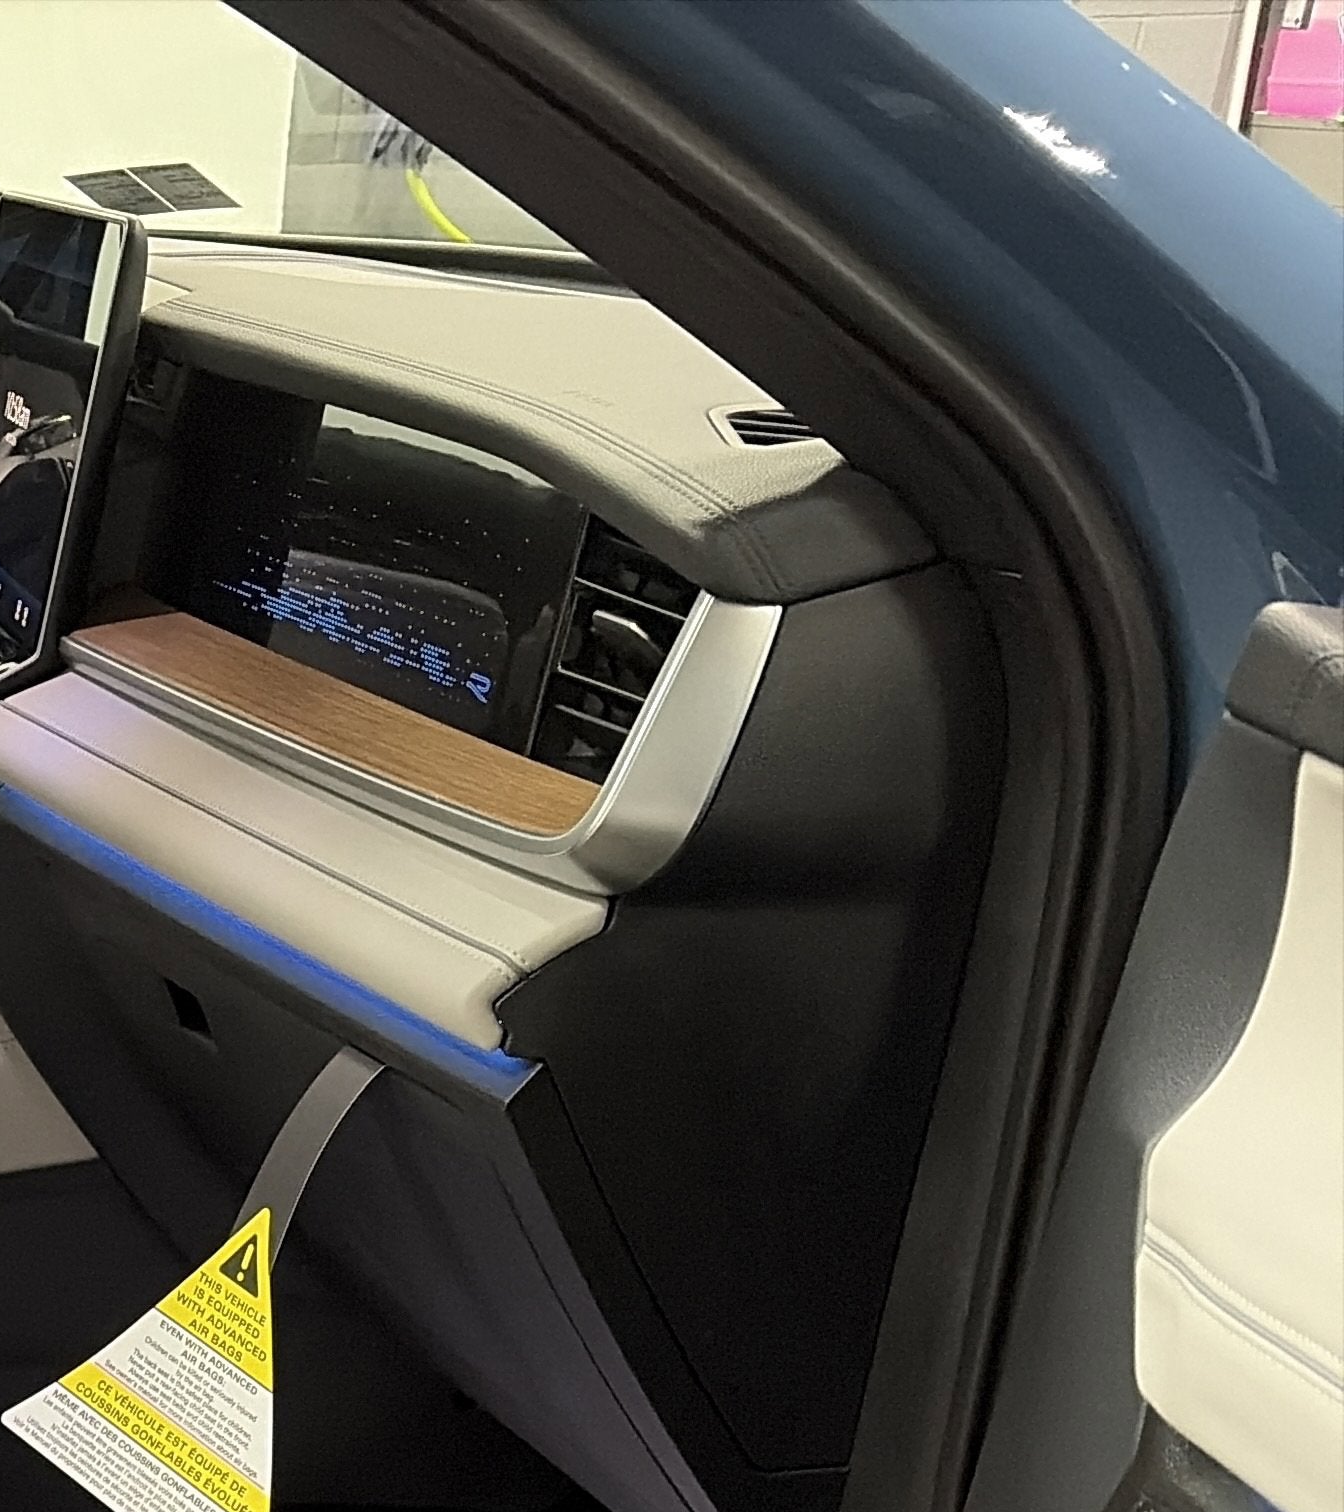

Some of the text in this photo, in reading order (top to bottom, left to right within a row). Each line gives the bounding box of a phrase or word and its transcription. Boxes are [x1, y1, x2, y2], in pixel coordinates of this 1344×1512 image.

[176, 1290, 266, 1361] WITH ADVANCED
[193, 1285, 259, 1339] IS EQUIPPED
[199, 1270, 266, 1327] THIS VEHICLE
[159, 1319, 257, 1395] EVEN WITH ADVANCED
[180, 1349, 197, 1365] AIR
[188, 1318, 242, 1362] AIR BAGS
[51, 1389, 79, 1413] MÊME
[77, 1409, 101, 1429] AVEC
[100, 1425, 118, 1442] DES
[117, 1439, 160, 1475] COUSSINS
[75, 1381, 130, 1427] COUSSINS
[127, 1423, 202, 1482] GONFLABLES
[97, 1379, 247, 1497] CE VÉHICULE EST ÉQUIPÉ DE
